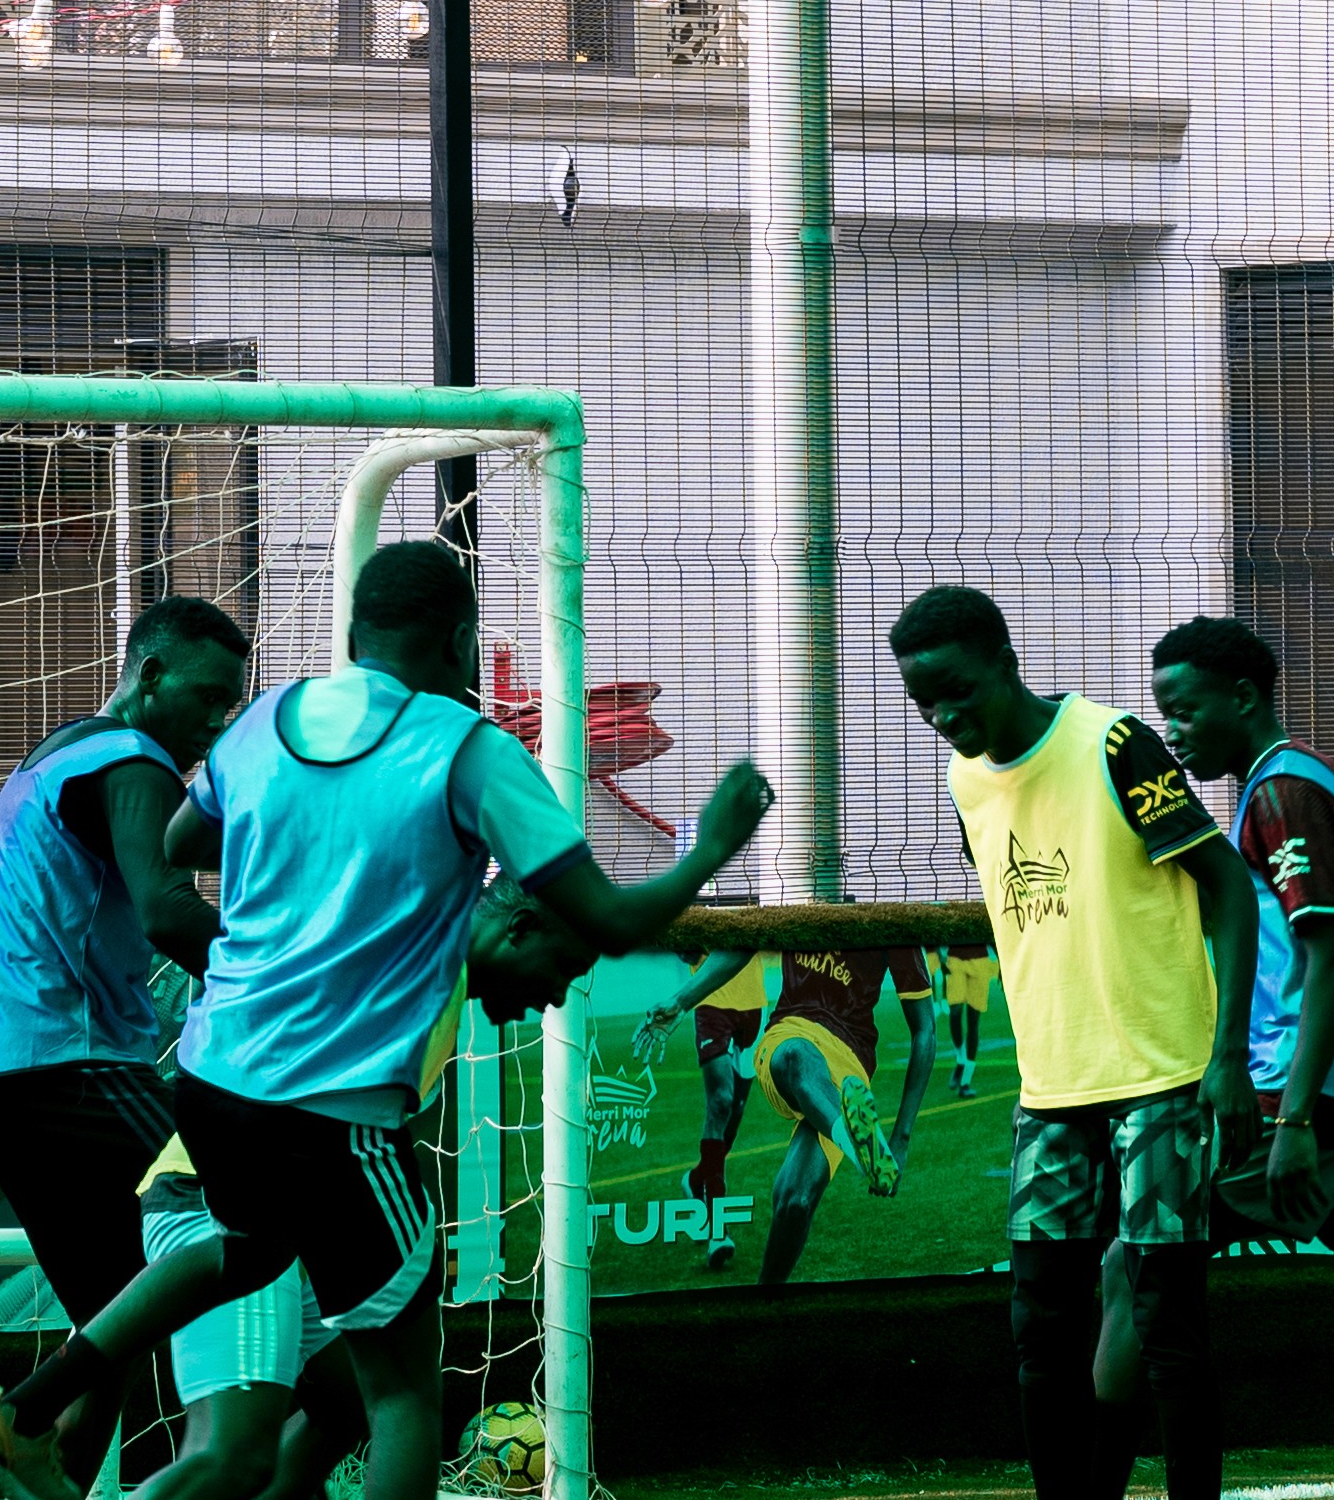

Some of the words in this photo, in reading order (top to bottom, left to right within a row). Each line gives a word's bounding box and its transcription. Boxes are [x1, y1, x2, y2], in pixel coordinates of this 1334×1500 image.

[1127, 769, 1186, 818] DXC
[1001, 882, 1069, 933] Arena
[1017, 885, 1044, 900] Merri
[1046, 884, 1067, 896] Mor
[622, 1105, 650, 1120] Mor
[587, 1120, 647, 1151] rena
